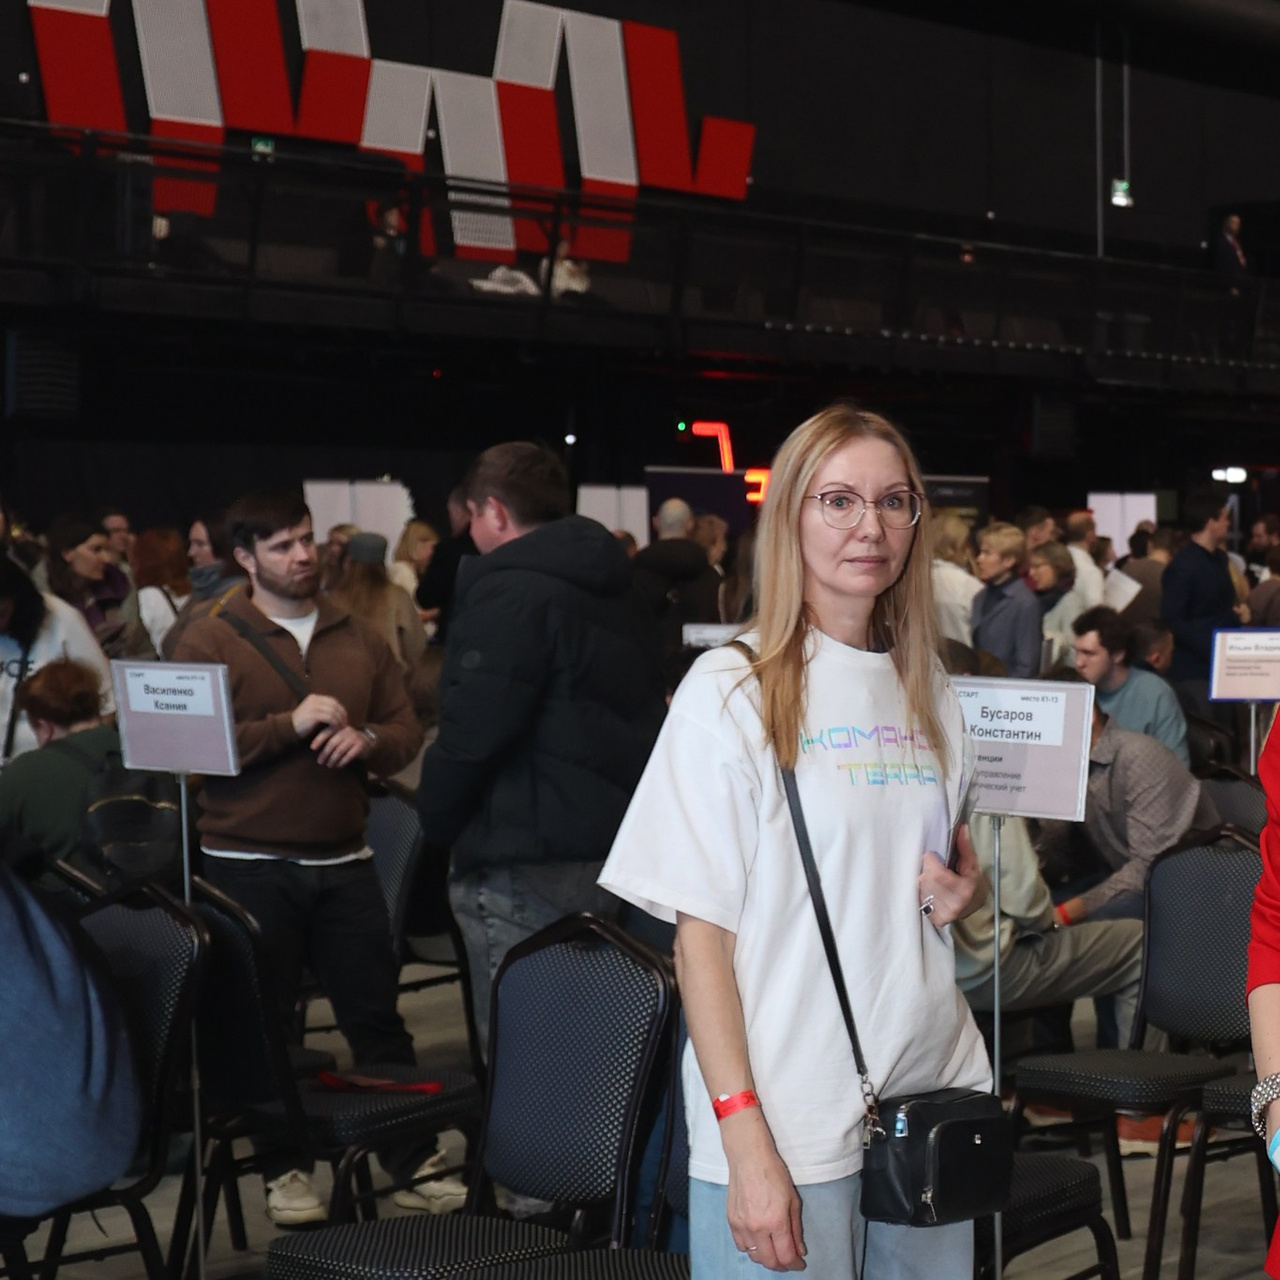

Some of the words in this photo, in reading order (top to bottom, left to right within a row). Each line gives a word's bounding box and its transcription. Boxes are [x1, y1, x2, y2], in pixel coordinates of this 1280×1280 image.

[143, 684, 195, 697] Василенко
[958, 691, 979, 699] СТАРТ
[153, 700, 188, 712] Ксения
[980, 706, 1034, 722] Бусаров
[969, 724, 1042, 741] Константин
